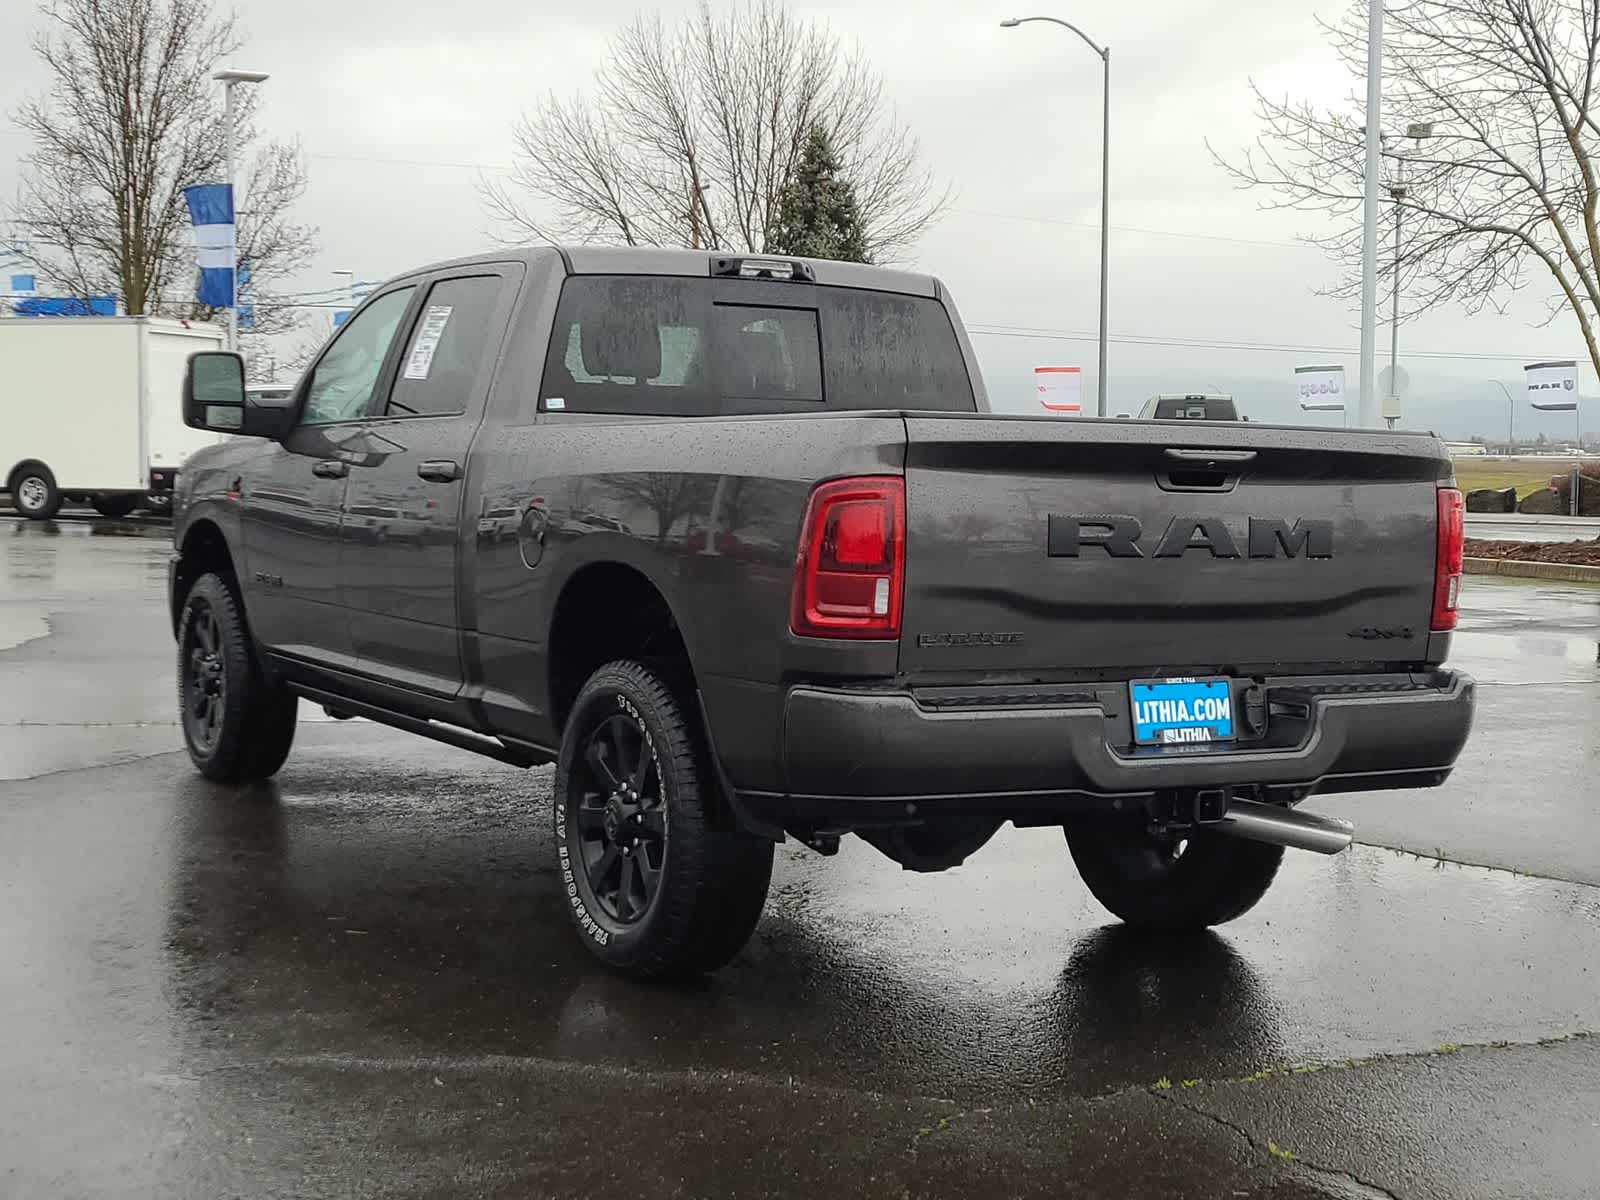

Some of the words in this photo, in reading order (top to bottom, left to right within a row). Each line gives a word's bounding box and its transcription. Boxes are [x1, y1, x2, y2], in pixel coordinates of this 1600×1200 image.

[1047, 512, 1334, 559] RAM
[1135, 698, 1230, 724] LITHIA.COM
[1175, 727, 1212, 742] LITHIA
